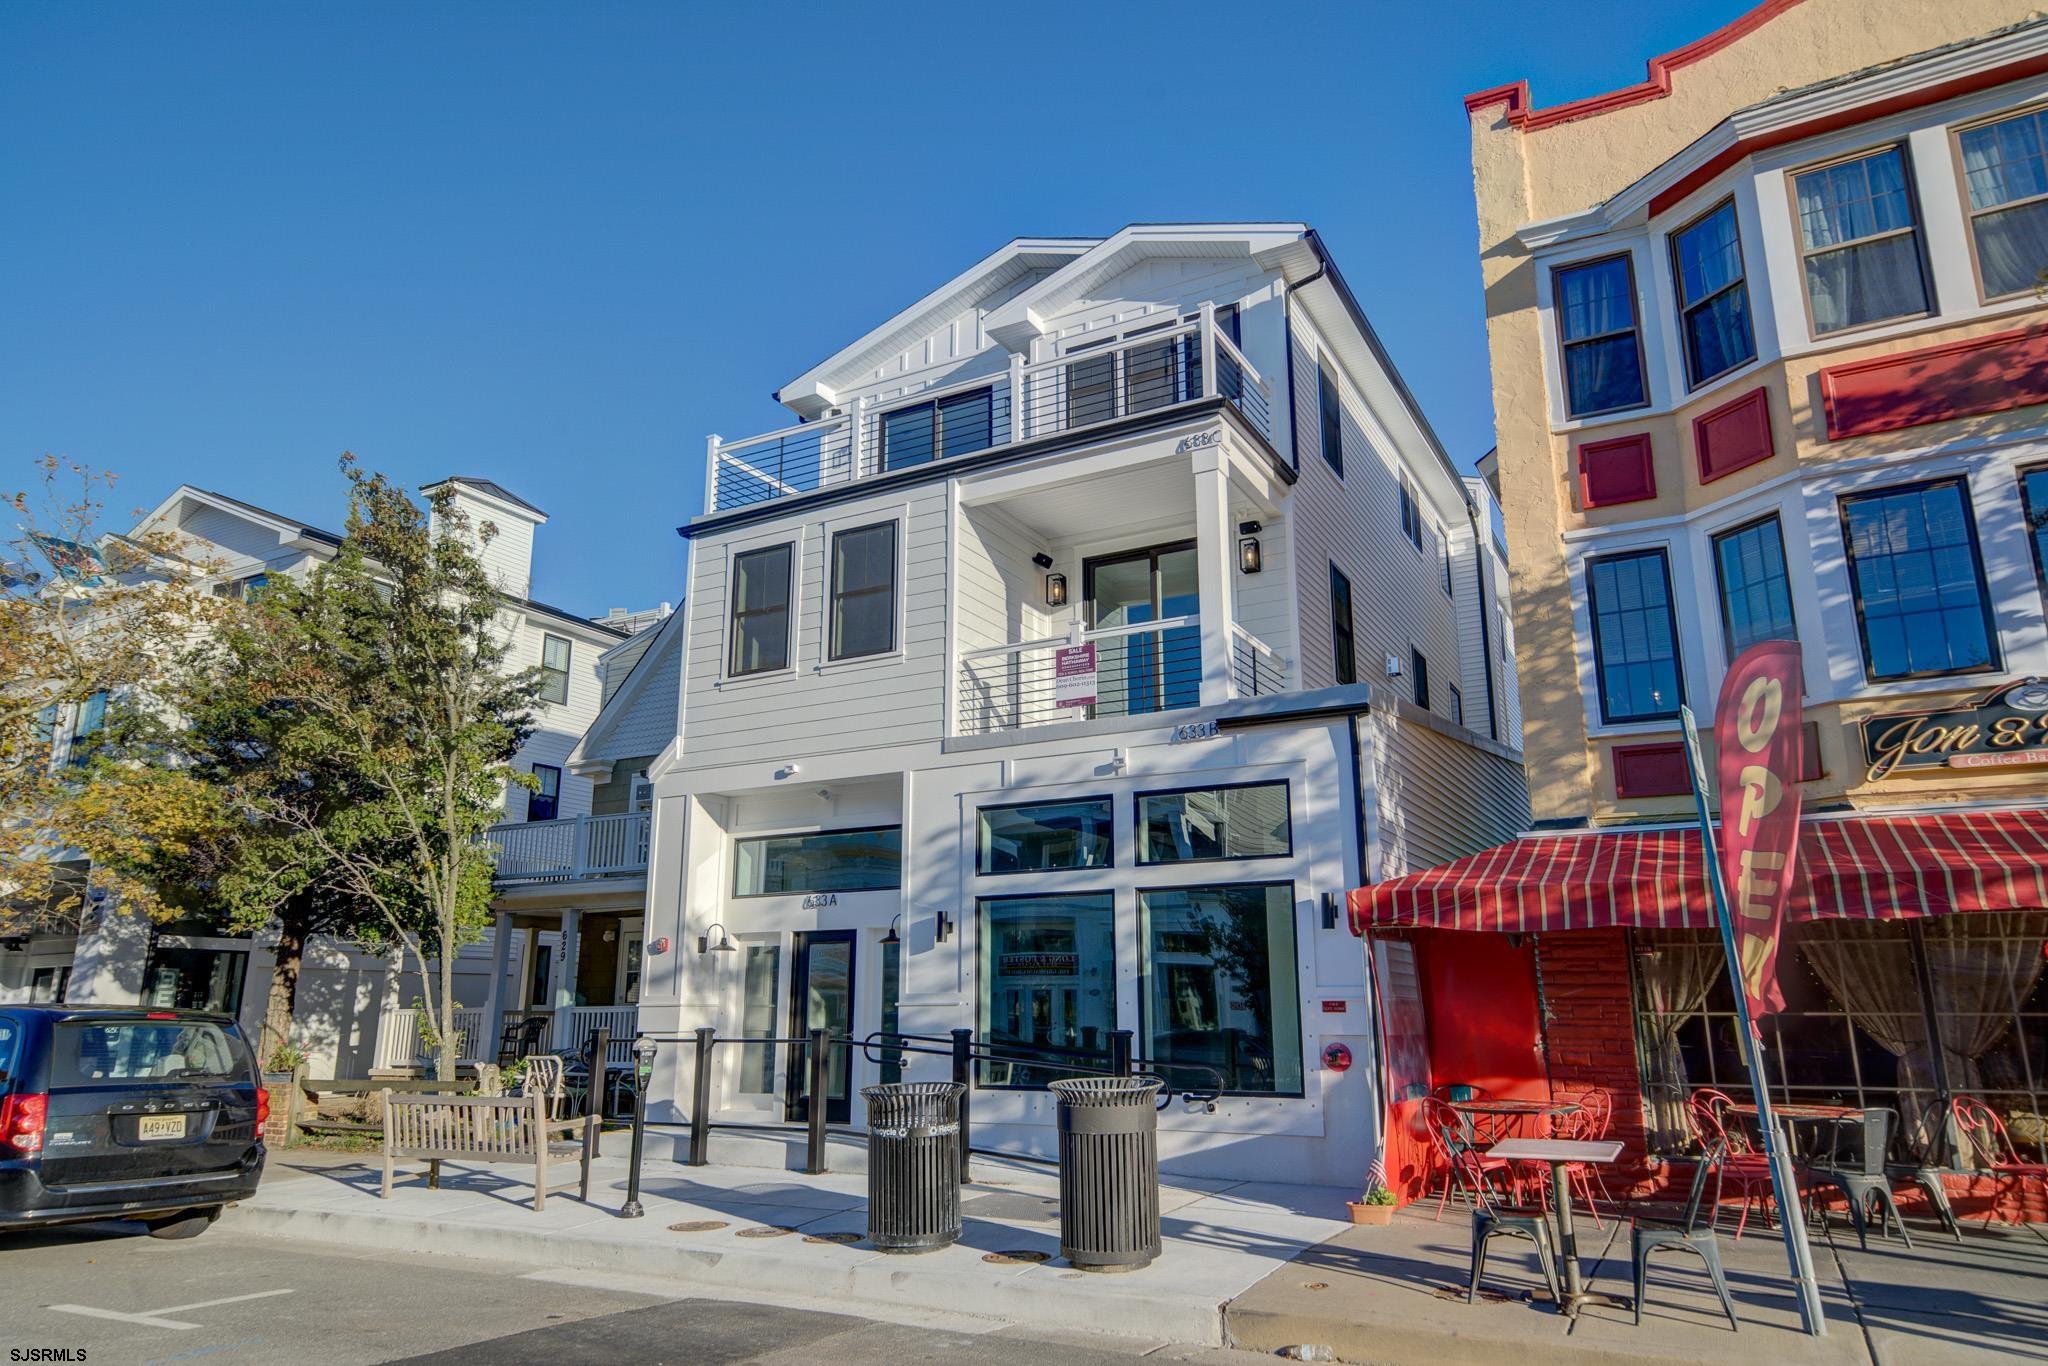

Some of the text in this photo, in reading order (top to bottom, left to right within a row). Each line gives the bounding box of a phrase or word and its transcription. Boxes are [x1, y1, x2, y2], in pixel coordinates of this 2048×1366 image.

[1179, 721, 1219, 740] 633 B
[1866, 717, 1981, 783] Jon
[1992, 717, 2030, 747] &
[1967, 751, 2018, 767] Coffee
[559, 930, 569, 962] 629
